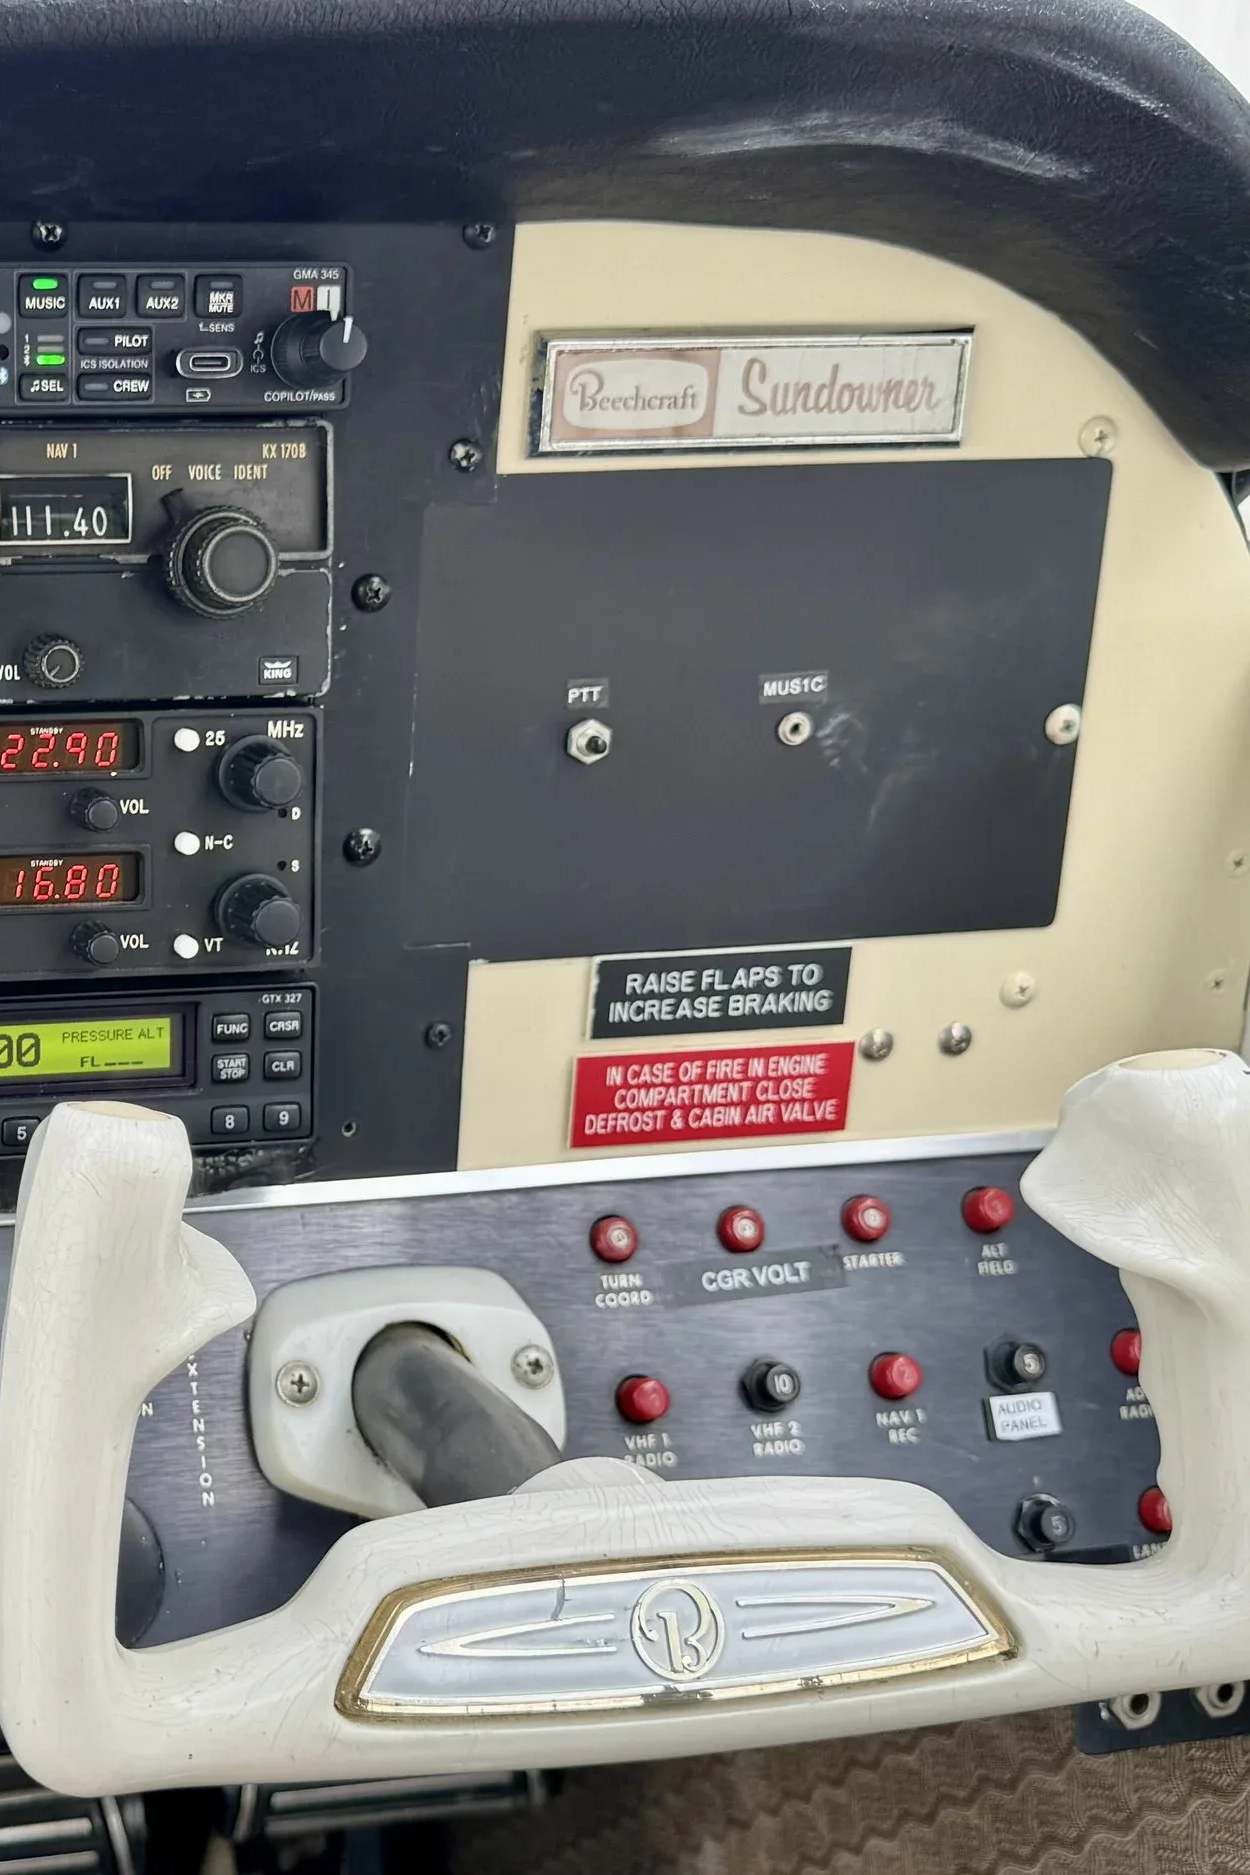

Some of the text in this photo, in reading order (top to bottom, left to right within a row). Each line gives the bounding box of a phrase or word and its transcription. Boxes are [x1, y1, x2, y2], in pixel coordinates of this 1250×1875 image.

[293, 269, 339, 280] GMA 345
[26, 298, 65, 309] MUSIC
[89, 298, 120, 309] AUX1
[146, 298, 179, 309] AUX2
[114, 336, 147, 347] PILOT
[80, 359, 148, 369] ICS ISOLATION
[113, 381, 149, 393] CREW
[570, 369, 698, 413] Beechcraft
[738, 357, 944, 418] Sundowner
[264, 391, 336, 403] COPILOT/PASS
[47, 444, 77, 458] NAV 1
[262, 443, 306, 459] KX 170B
[189, 465, 222, 481] VOICE
[234, 465, 268, 479] IDENT
[12, 505, 108, 537] 111.40
[263, 669, 292, 680] KING
[568, 686, 603, 703] PTT
[267, 721, 305, 739] MHz
[120, 800, 149, 815] VOL
[205, 835, 234, 850] N-C
[30, 859, 63, 867] STANDBY
[625, 963, 823, 995] RAISE FLAPS TO
[609, 989, 835, 1023] INCREASE BRAKING
[62, 1027, 164, 1044] PRESSURE ALT
[217, 1023, 248, 1035] FUNC
[606, 1053, 829, 1086] IN CASE OF FIRE IN ENGINE
[614, 1077, 817, 1110] COMPARTMENT CLOSE
[585, 1099, 839, 1136] DEFROST & CABIN AIR VALVE
[842, 1252, 904, 1270] STARTER
[600, 1273, 643, 1288] TURN
[701, 1261, 812, 1292] CGR VOLT
[595, 1290, 653, 1308] COORD
[997, 1398, 1042, 1416] AUDIO
[1001, 1416, 1047, 1432] PANEL
[752, 1439, 804, 1456] RADIO
